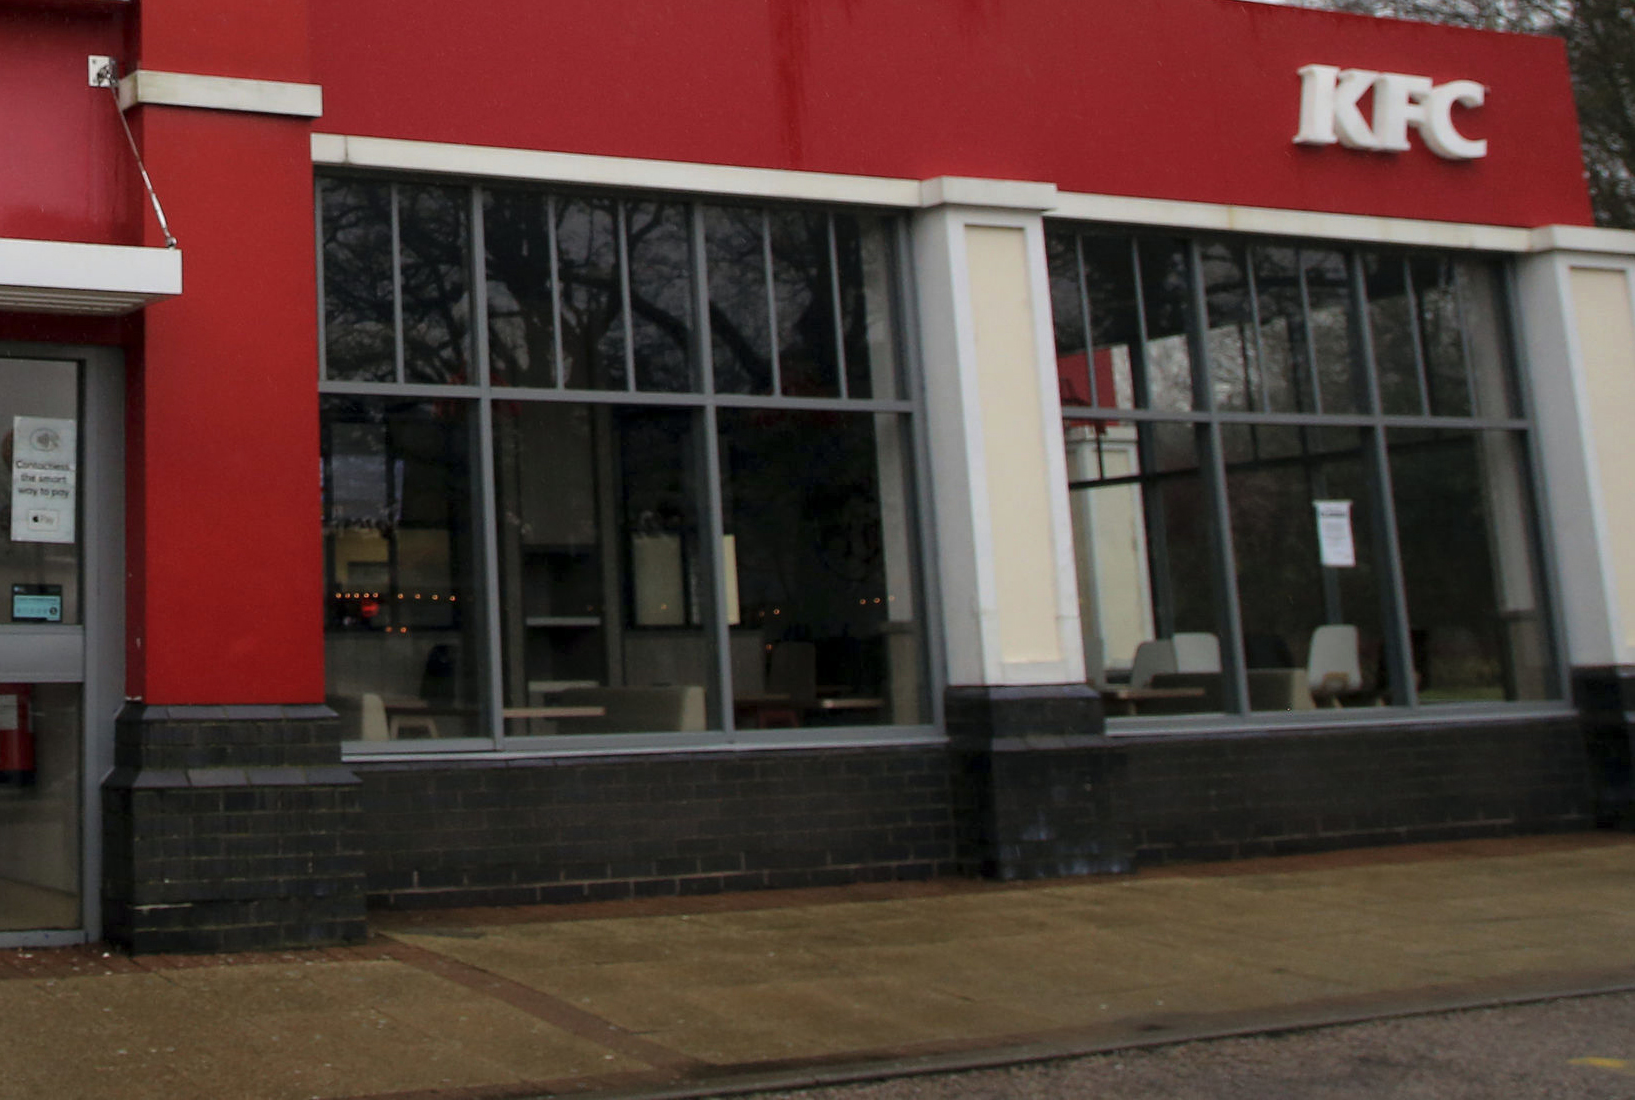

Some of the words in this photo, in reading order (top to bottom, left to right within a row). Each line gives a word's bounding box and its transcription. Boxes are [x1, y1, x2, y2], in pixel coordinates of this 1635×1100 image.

[1292, 63, 1488, 160] KFC
[38, 475, 66, 484] smart
[18, 487, 38, 498] way
[41, 487, 50, 496] to
[52, 489, 69, 500] pay
